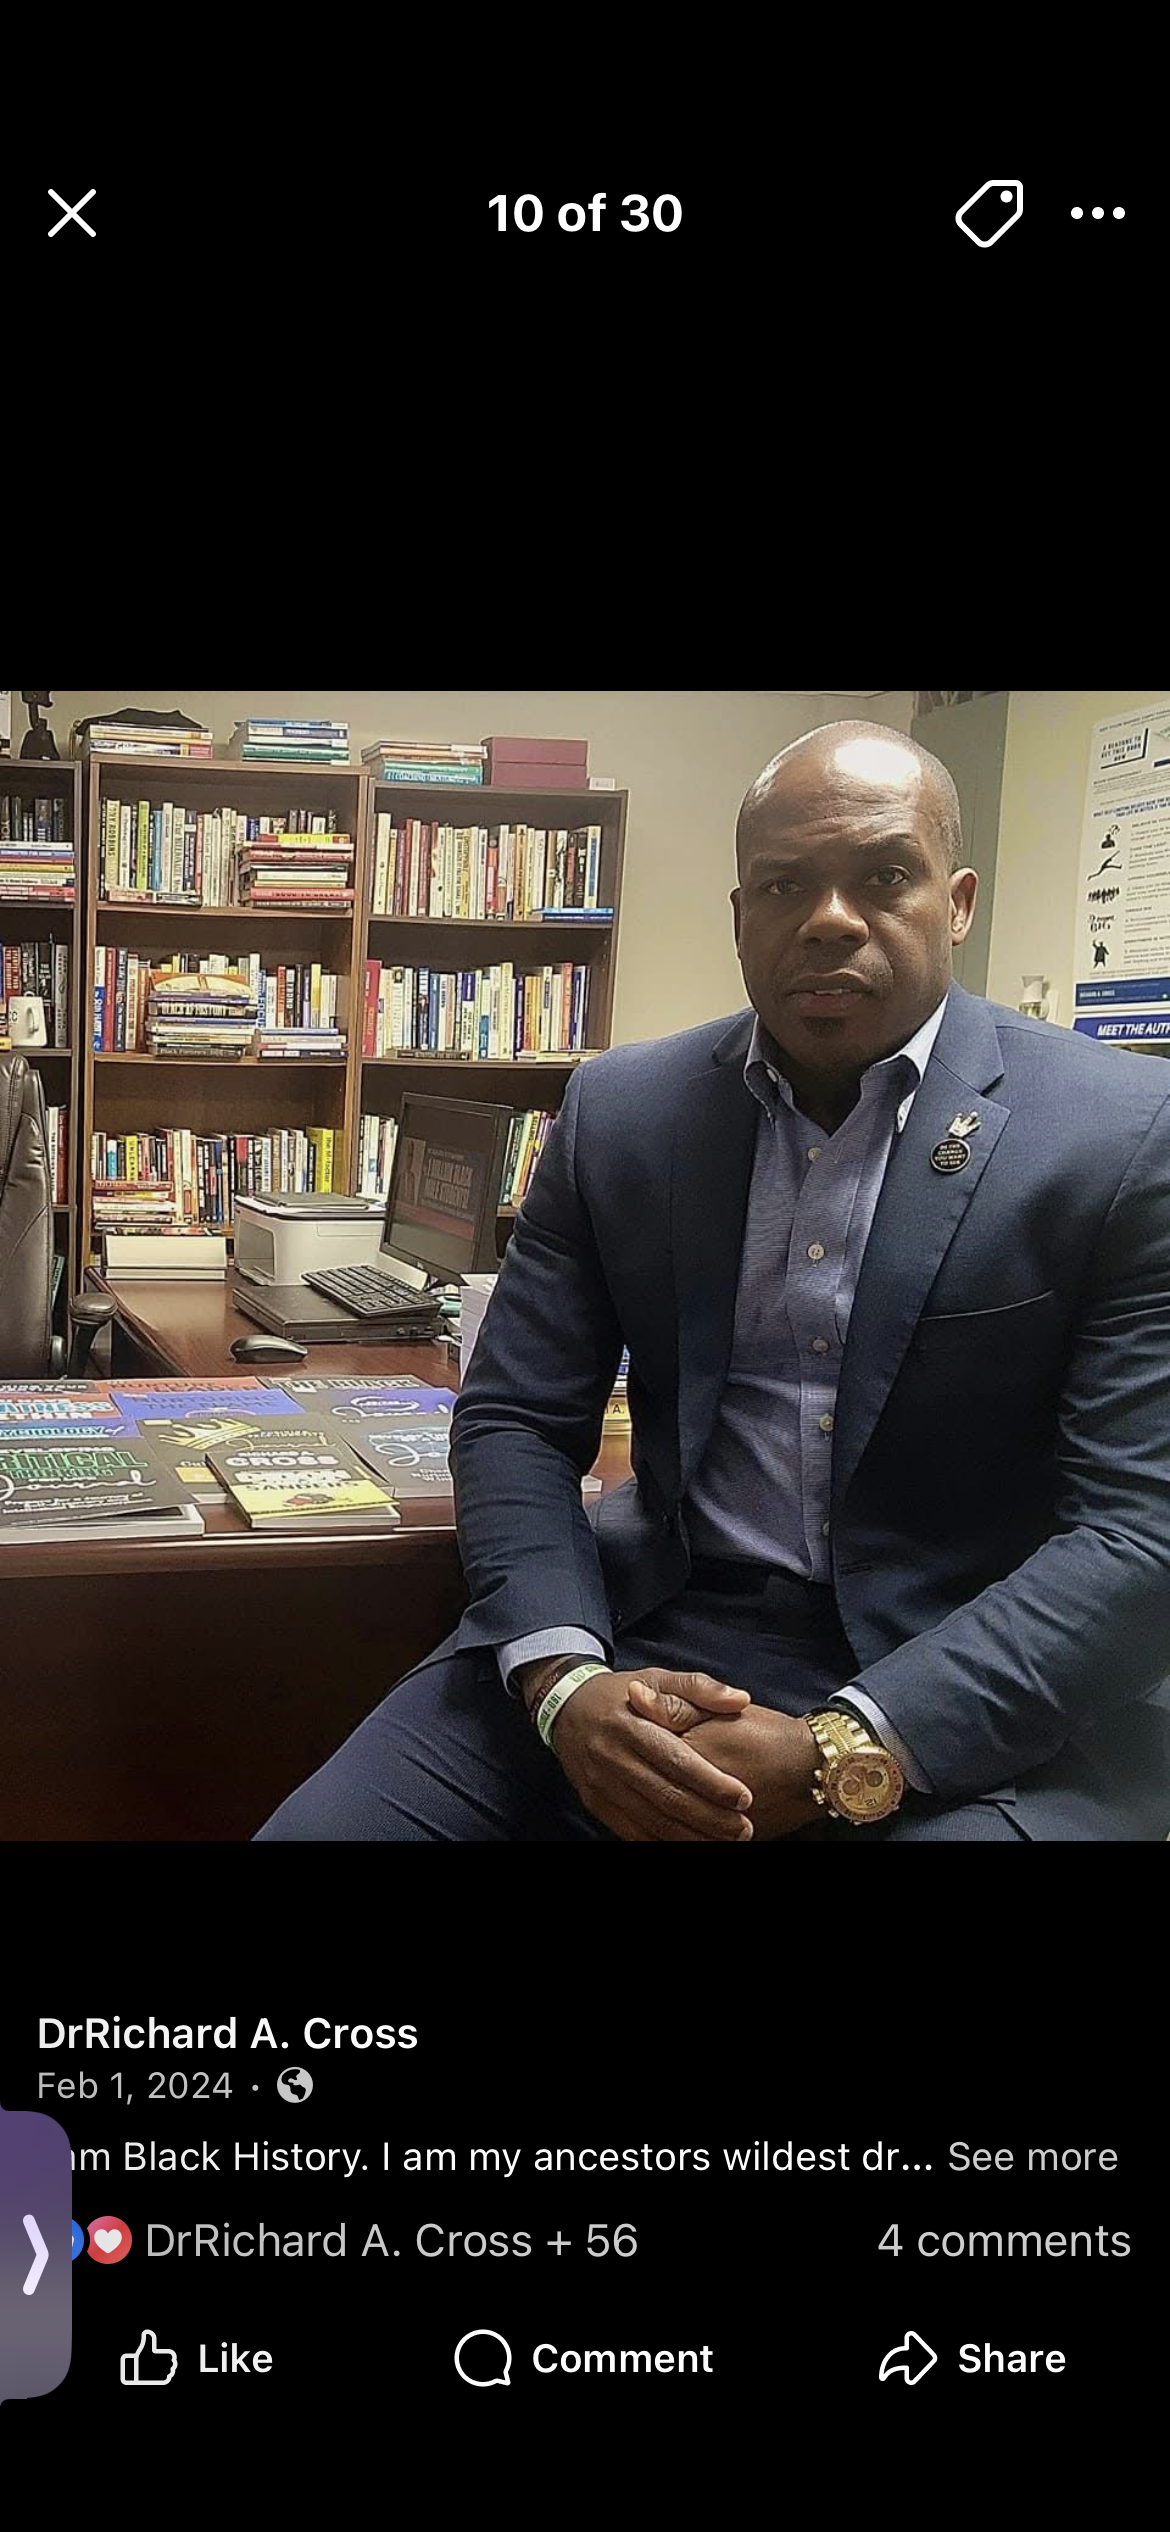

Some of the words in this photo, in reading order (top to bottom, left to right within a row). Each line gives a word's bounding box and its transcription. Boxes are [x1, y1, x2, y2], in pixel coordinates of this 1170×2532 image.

[1097, 1024, 1125, 1037] MEET
[1125, 1023, 1146, 1035] THE
[225, 1456, 339, 1467] CROSS
